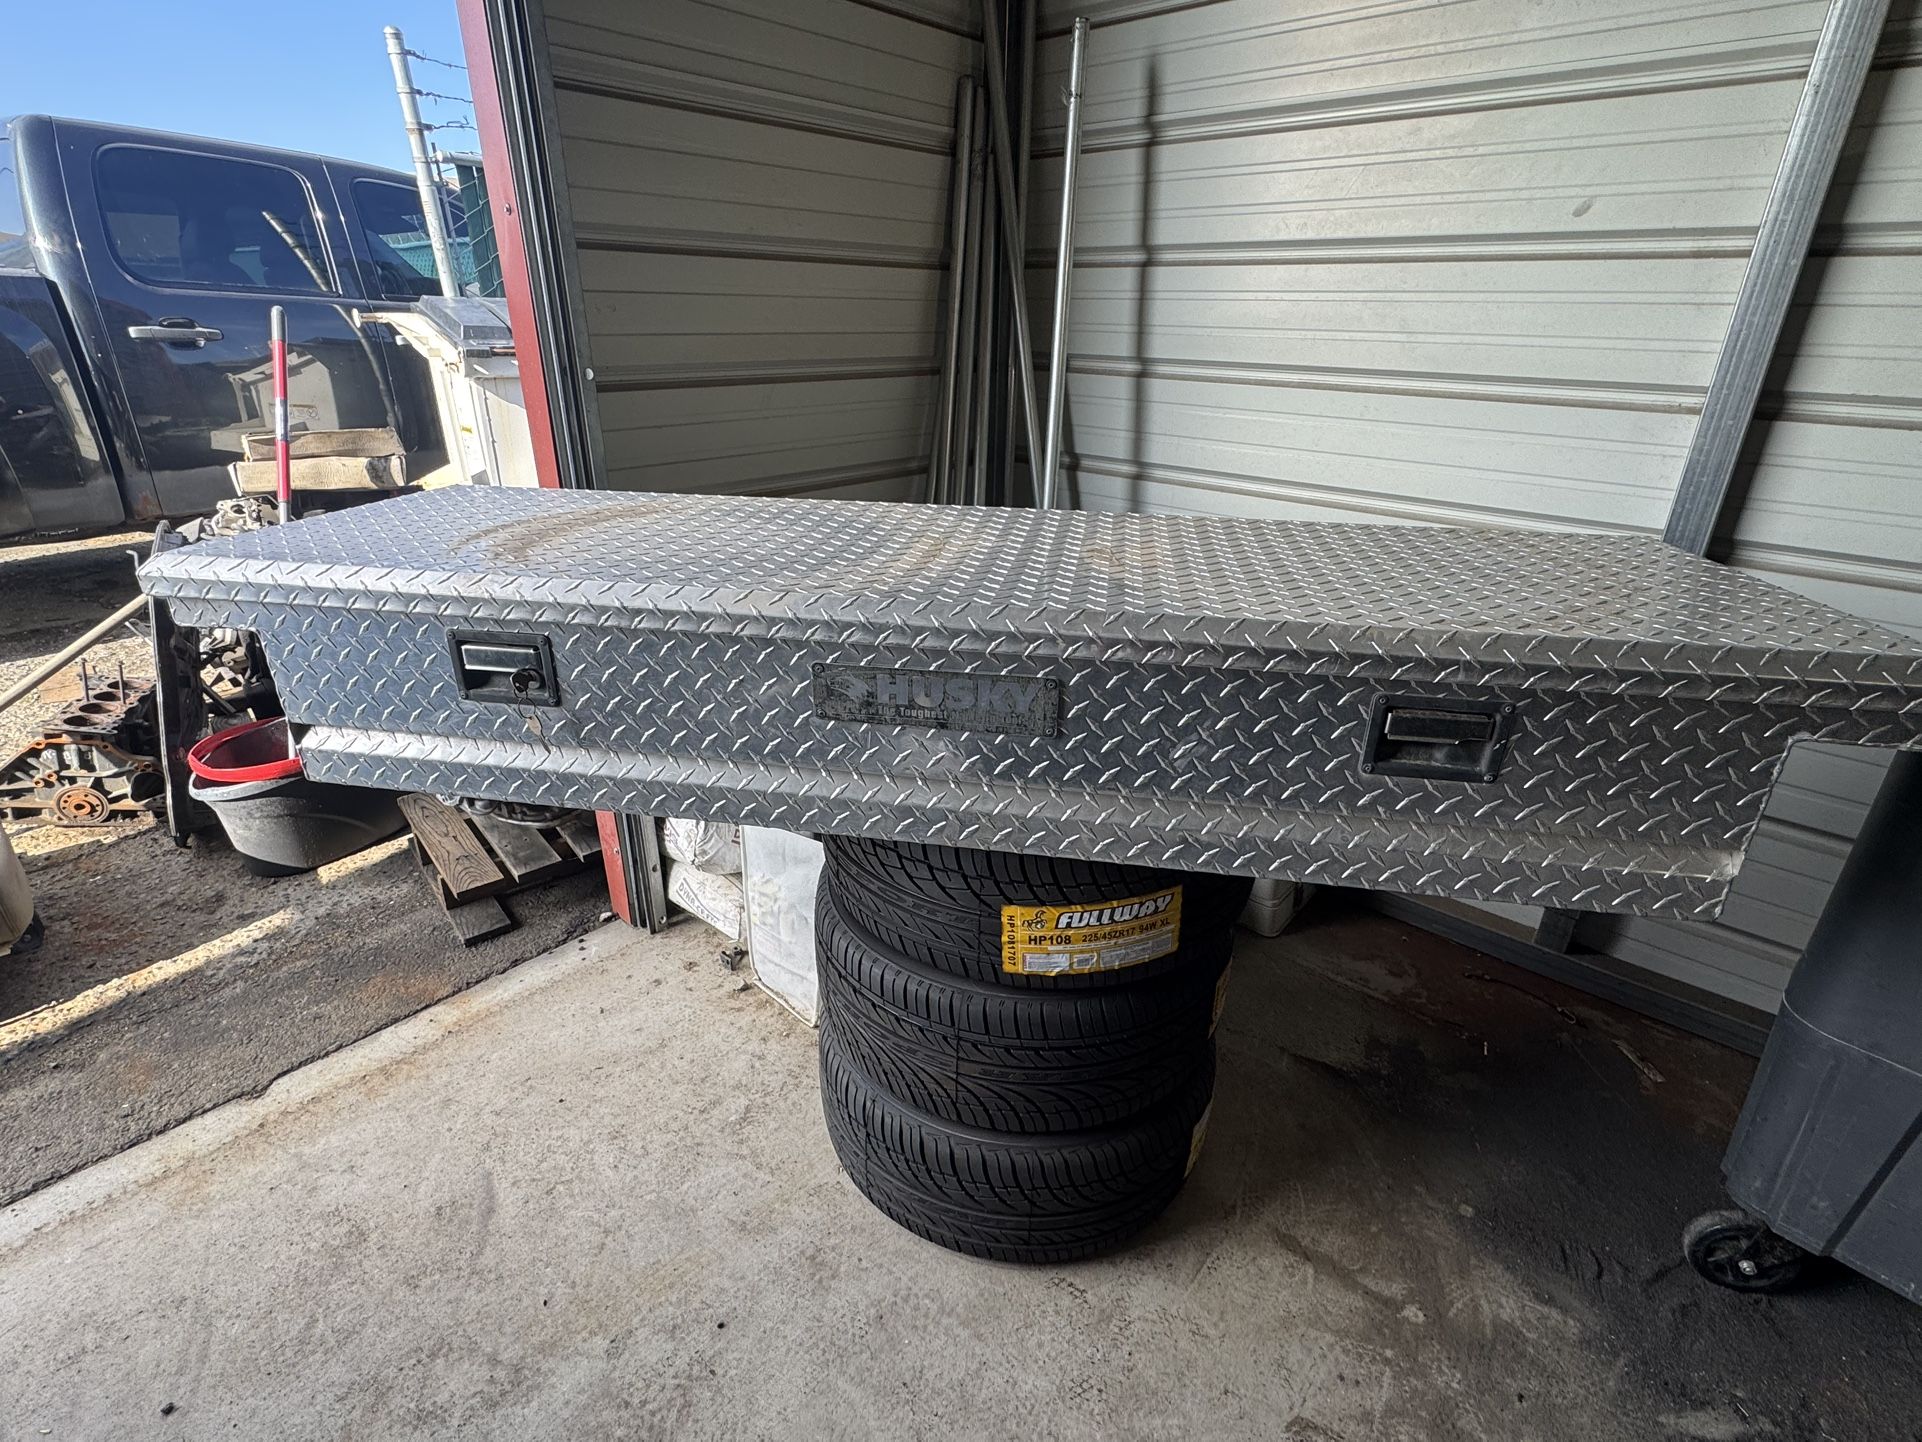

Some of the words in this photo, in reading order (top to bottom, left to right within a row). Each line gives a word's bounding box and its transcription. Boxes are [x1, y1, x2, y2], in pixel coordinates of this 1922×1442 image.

[876, 673, 1042, 712] HUSKY
[899, 707, 949, 719] Toughest
[1056, 893, 1174, 929] FULLWAY
[1006, 914, 1016, 966] HP1081707
[1028, 934, 1072, 945] HP108
[1082, 927, 1136, 943] 225/45ZR17
[1138, 921, 1157, 933] 94W
[1160, 917, 1170, 926] XL
